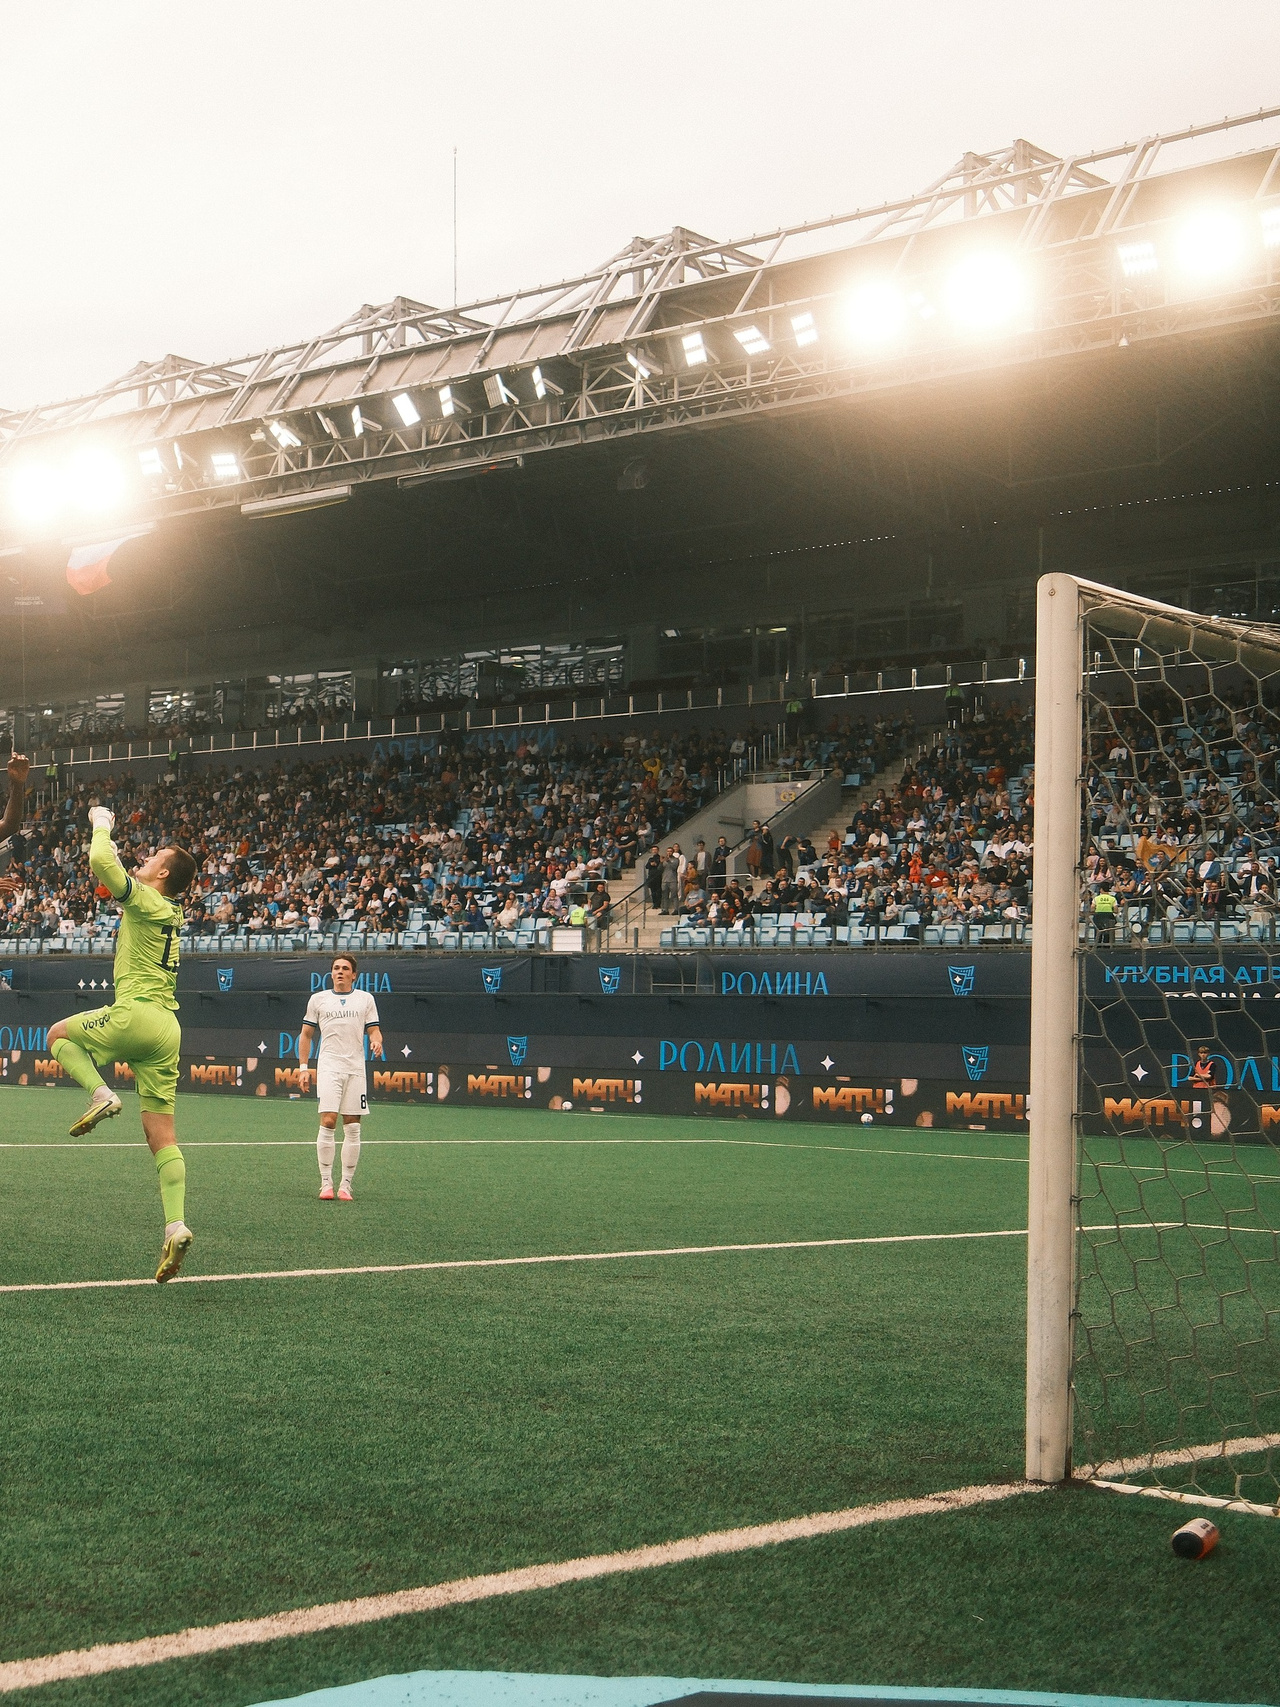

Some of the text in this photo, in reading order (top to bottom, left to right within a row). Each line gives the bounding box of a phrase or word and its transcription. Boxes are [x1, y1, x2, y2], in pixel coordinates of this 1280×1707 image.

[1105, 966, 1225, 984] КЛУБНАЯ
[326, 1010, 359, 1019] РОДИНА
[190, 1064, 243, 1087] МАТЧ!
[373, 1071, 434, 1095] МАТЧ!
[467, 1073, 532, 1098] МАТЧ!
[361, 1095, 367, 1109] 8
[572, 1077, 642, 1104] МАТЧ!
[694, 1082, 769, 1110] МАТЧ!
[812, 1086, 894, 1115] МАТЧ!
[1104, 1097, 1203, 1129] МАТЧ!
